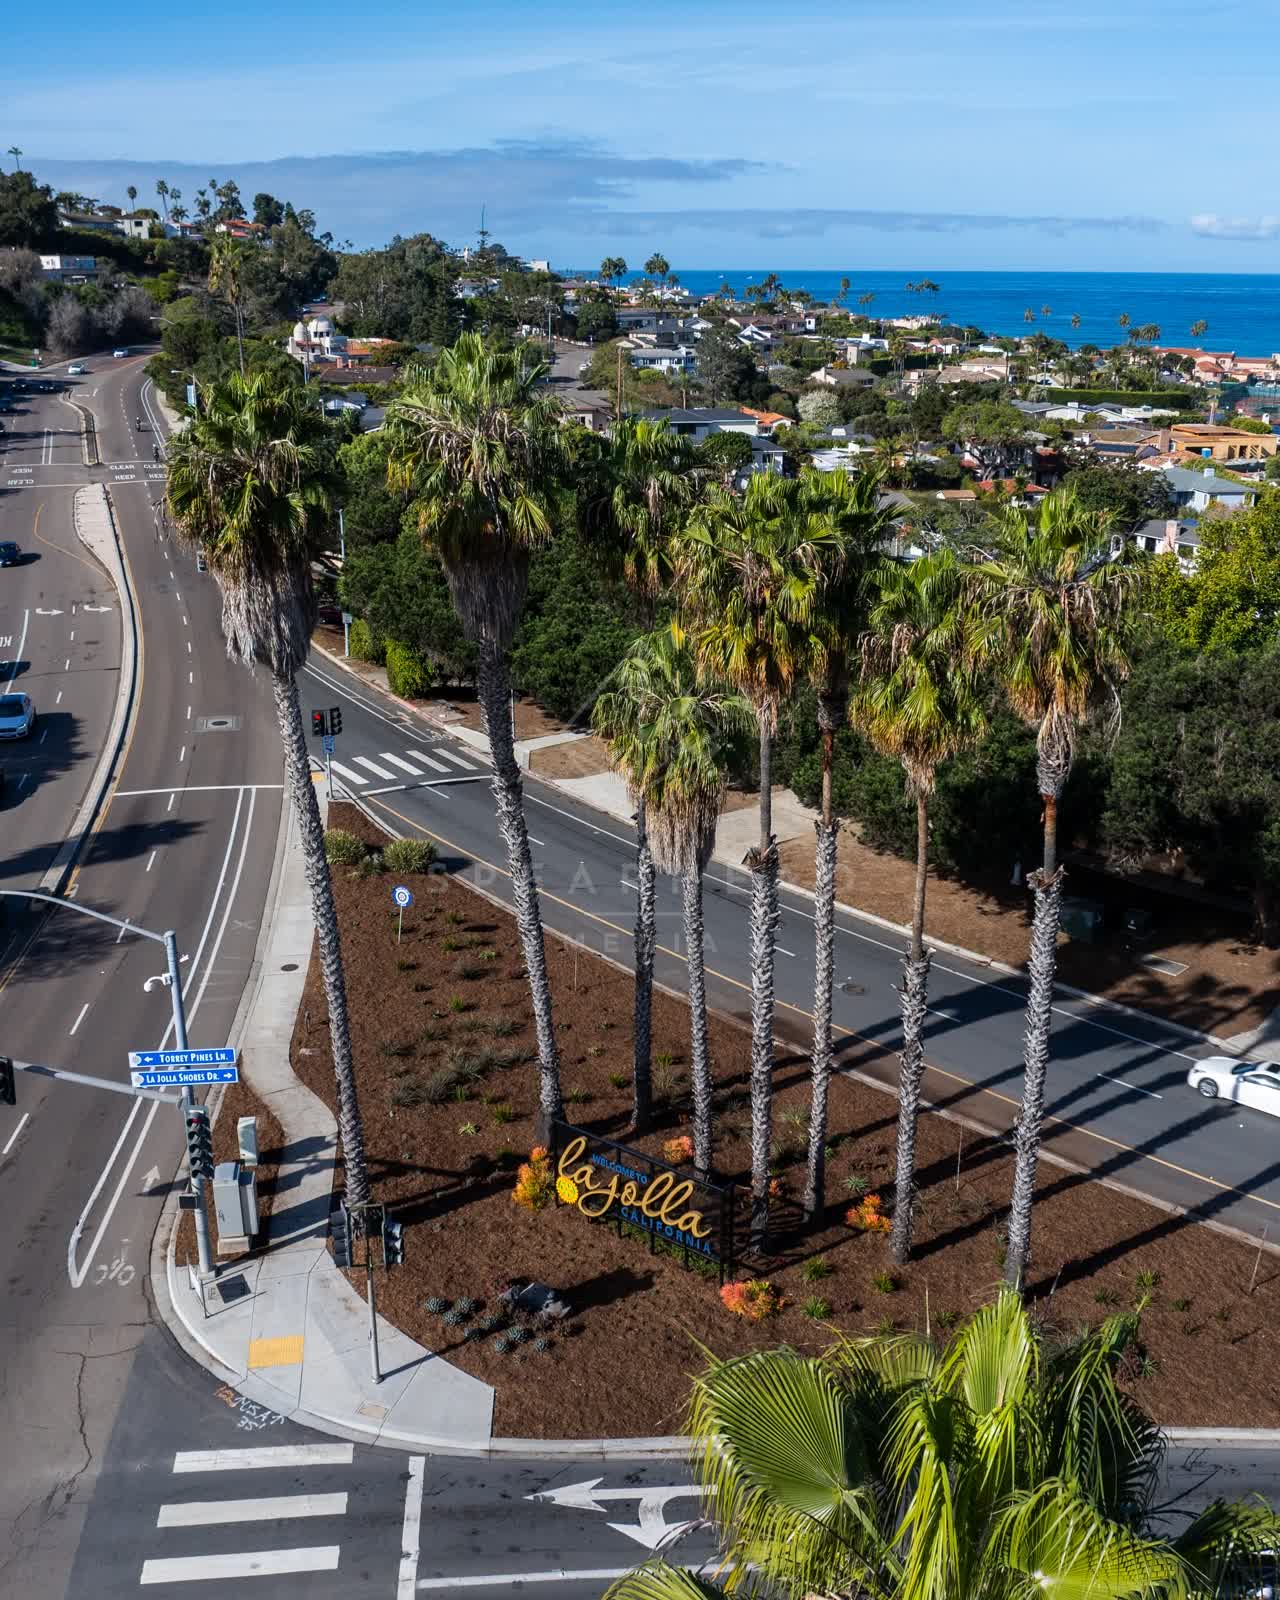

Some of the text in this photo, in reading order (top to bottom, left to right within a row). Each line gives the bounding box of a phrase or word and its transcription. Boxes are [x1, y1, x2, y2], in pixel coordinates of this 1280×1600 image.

[160, 1052, 228, 1063] TORREY PINES LN.
[146, 1071, 220, 1084] LA JOLLA SHORES DR.
[592, 1154, 649, 1185] WELCOME TO
[620, 1206, 712, 1254] CALIFORNIA
